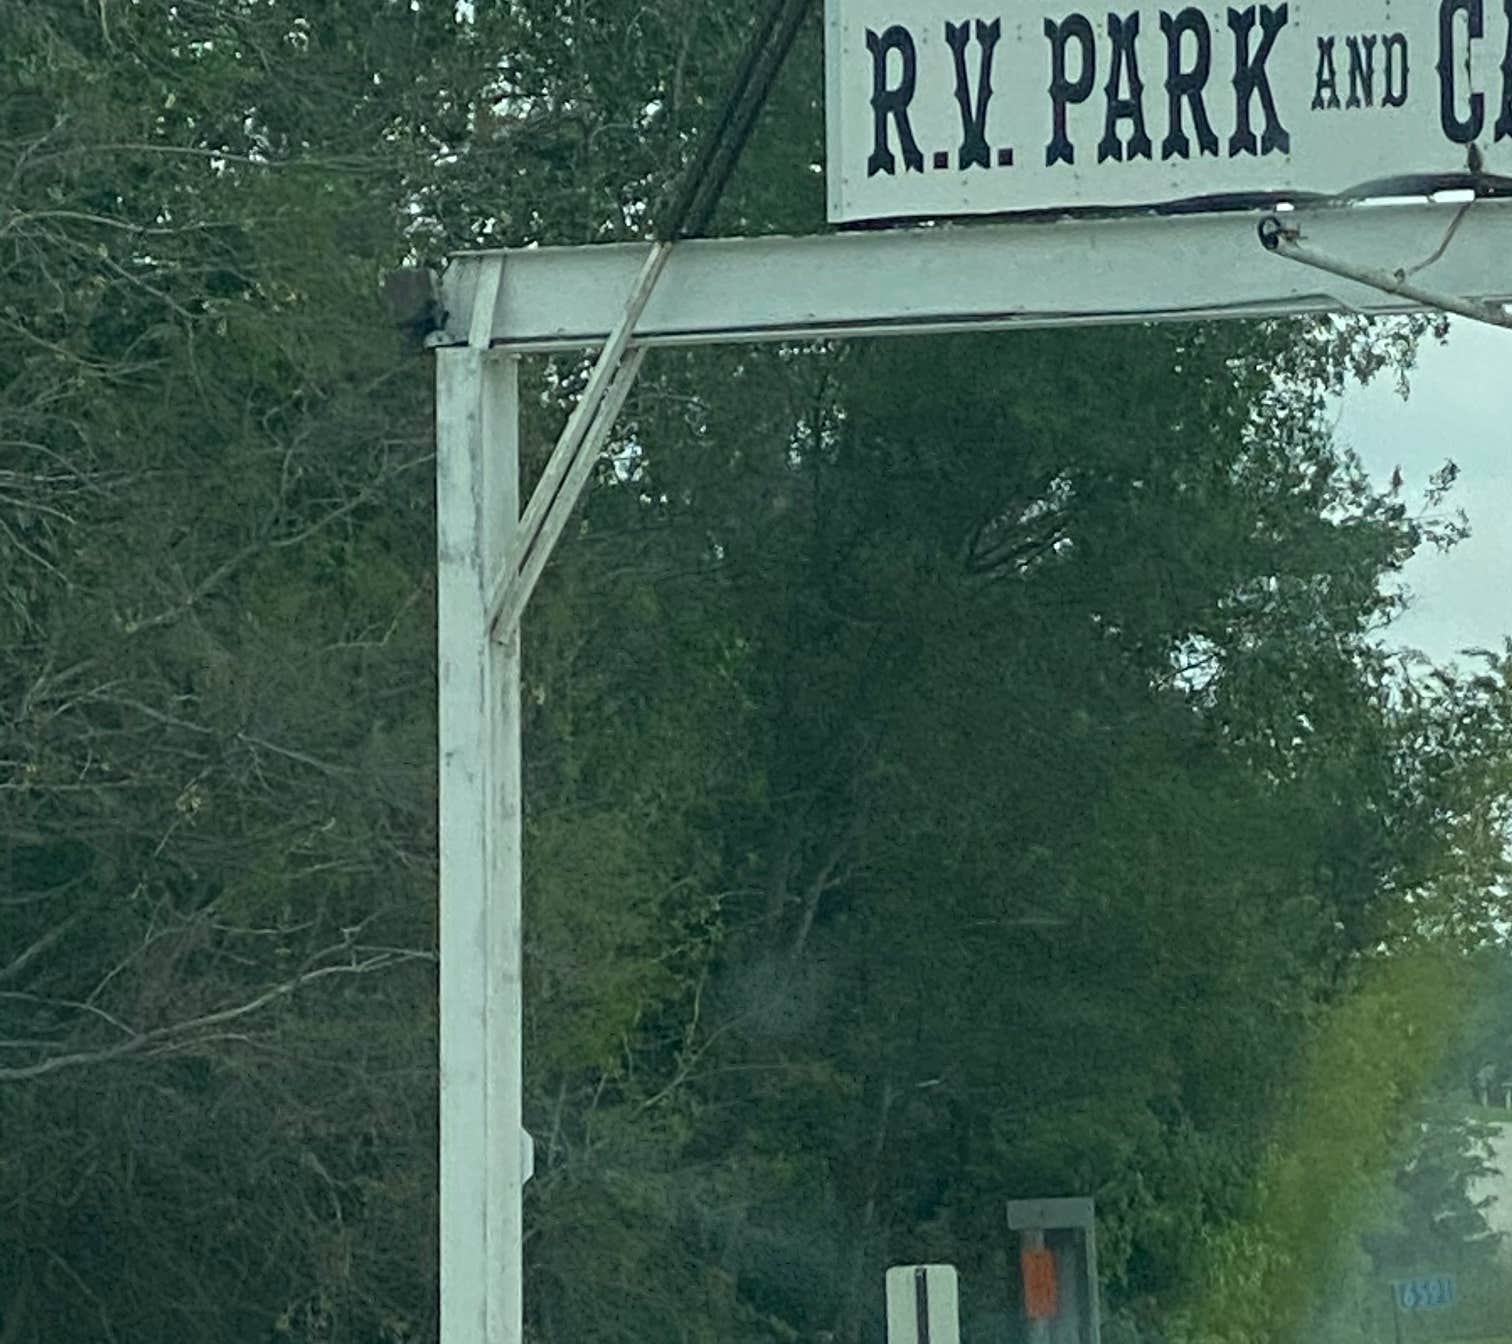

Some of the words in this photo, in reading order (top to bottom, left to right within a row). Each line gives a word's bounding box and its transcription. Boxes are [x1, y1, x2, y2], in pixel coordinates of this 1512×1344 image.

[866, 17, 1014, 178] R.V.
[1043, 3, 1290, 168] PARK
[1311, 32, 1409, 111] AND
